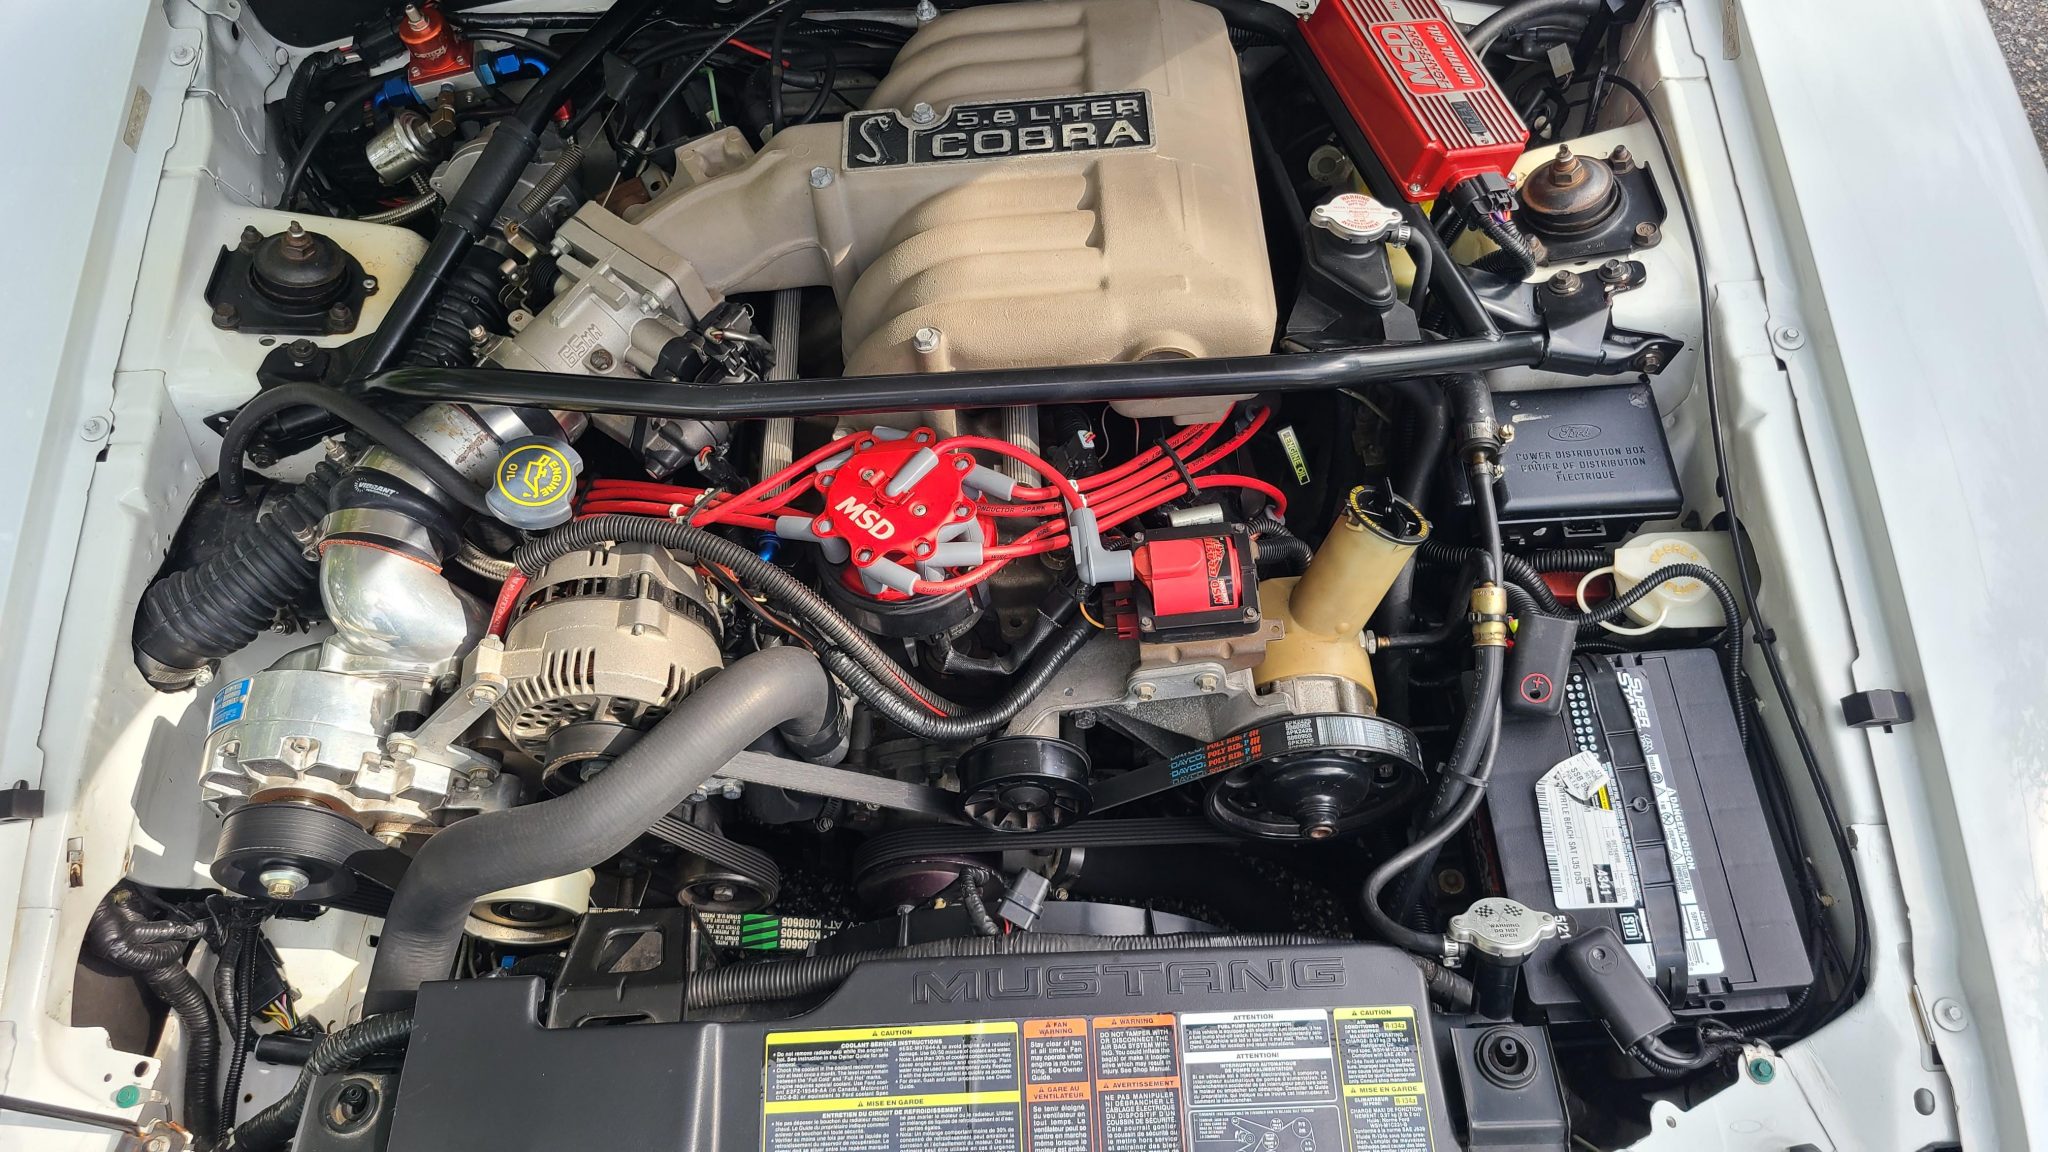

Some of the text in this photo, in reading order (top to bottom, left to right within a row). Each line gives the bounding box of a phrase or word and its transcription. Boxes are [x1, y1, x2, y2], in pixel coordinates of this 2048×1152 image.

[1380, 26, 1436, 86] MSD
[1440, 46, 1475, 85] DIGITAL
[957, 100, 1140, 127] 5.8 LITER
[932, 119, 1144, 158] COBRA
[558, 323, 602, 368] 65MM
[1558, 426, 1590, 438] Ford
[1284, 436, 1303, 468] ENGINE
[1515, 445, 1646, 462] POWER DISTRIBUTION BOX
[505, 463, 518, 481] OIL
[1579, 457, 1647, 469] DISTRIBUTION
[541, 461, 562, 497] ENGINE
[358, 481, 396, 496] VIBRANT
[834, 496, 895, 541] MSD
[1630, 676, 1651, 729] SUPER
[1208, 747, 1226, 759] POLY
[1208, 755, 1227, 767] POLY
[1558, 786, 1569, 818] MYRTLE
[1563, 818, 1573, 840] BEACH
[1670, 796, 1695, 870] DANGER/POISON
[1568, 840, 1577, 855] SAT
[1571, 856, 1580, 870] L35
[1595, 868, 1610, 896] 4341
[781, 917, 822, 930] K080605
[1554, 915, 1572, 940] 5/21
[1622, 915, 1638, 937] STD
[780, 928, 821, 940] K080605
[780, 939, 809, 950] 80605
[912, 958, 1348, 1005] MUSTANG
[1233, 1013, 1274, 1021] ATTENTION
[1236, 1052, 1280, 1060] ATTENTION!
[1113, 1081, 1174, 1089] AVERTISSEMENT
[904, 1107, 963, 1115] REFROIDISSEMENT
[1106, 1118, 1134, 1126] COUSSIN
